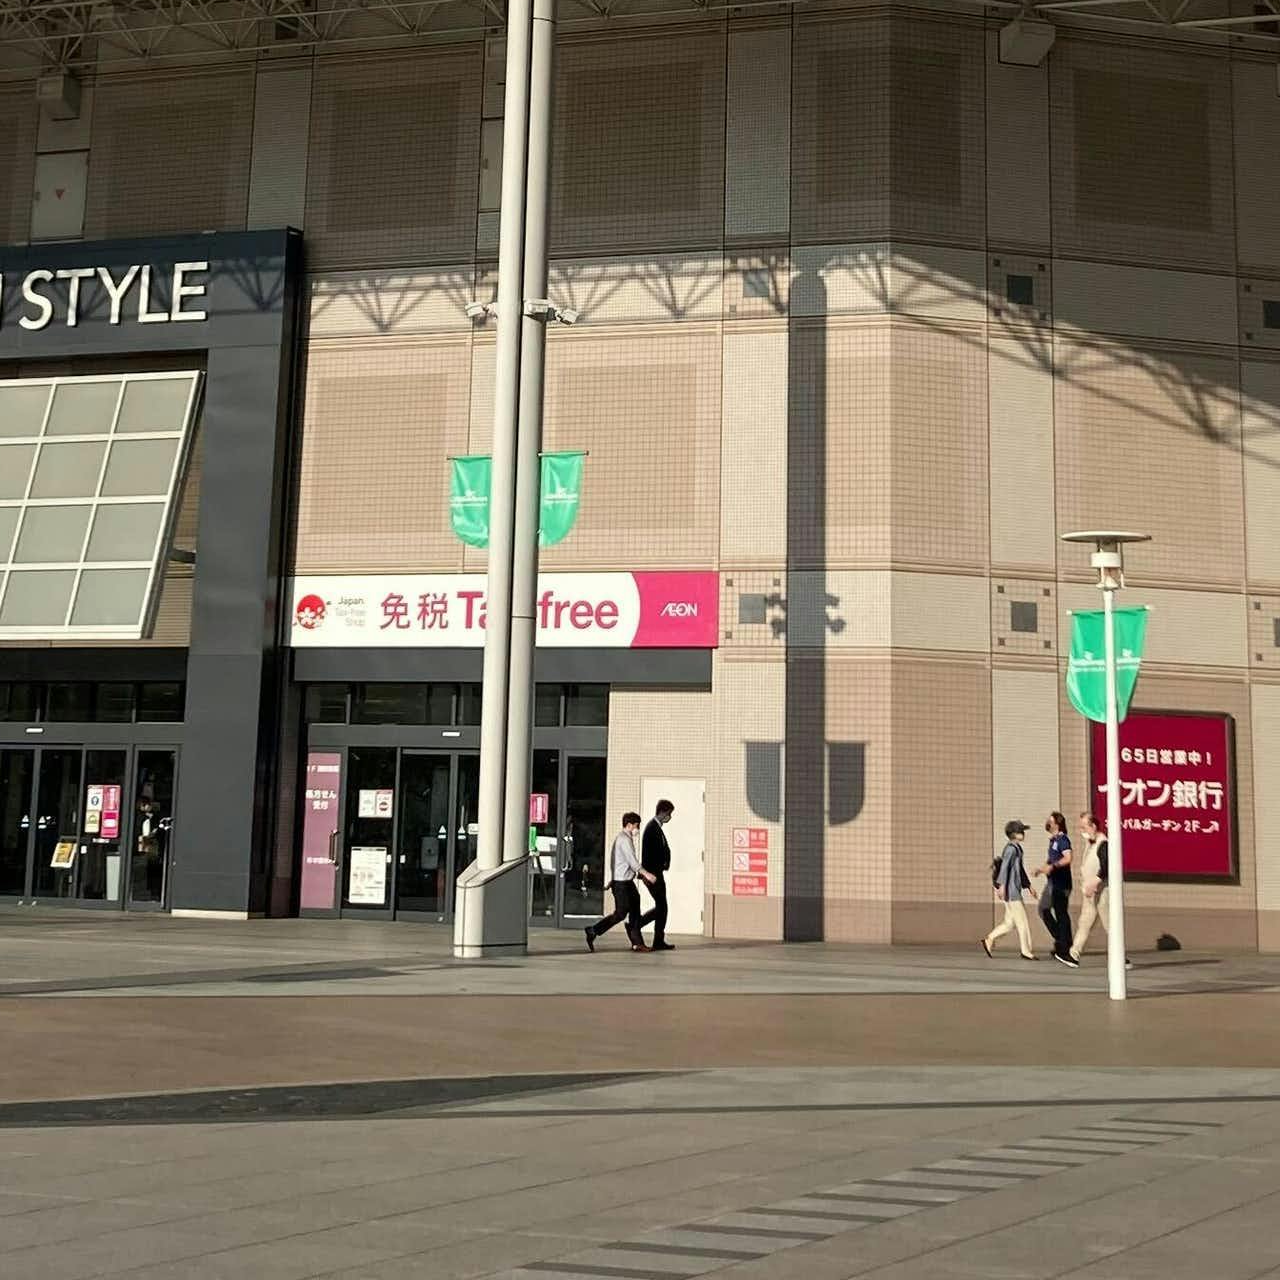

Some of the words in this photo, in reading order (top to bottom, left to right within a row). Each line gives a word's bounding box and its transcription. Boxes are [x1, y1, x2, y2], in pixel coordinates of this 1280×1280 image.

[18, 261, 209, 330] STYLE
[380, 592, 449, 630] 免税
[1098, 777, 1224, 820] オン銀行
